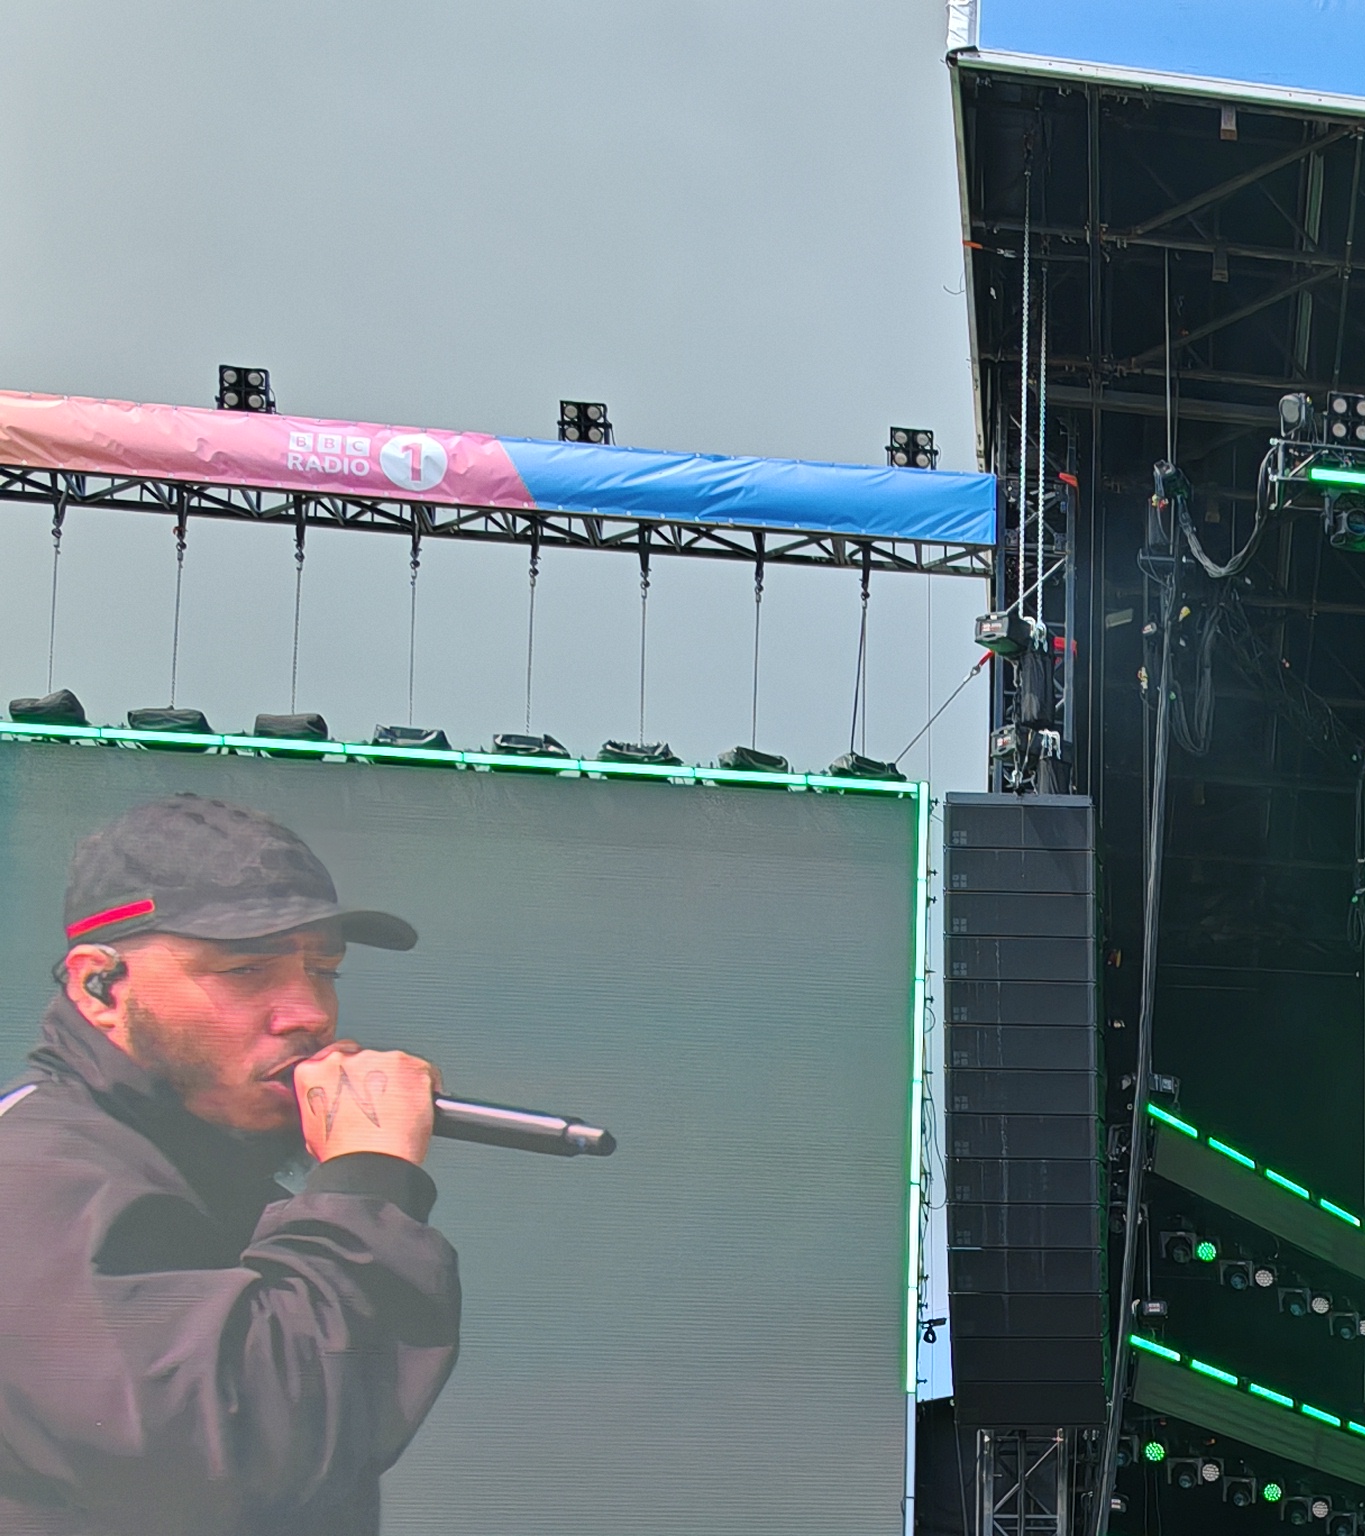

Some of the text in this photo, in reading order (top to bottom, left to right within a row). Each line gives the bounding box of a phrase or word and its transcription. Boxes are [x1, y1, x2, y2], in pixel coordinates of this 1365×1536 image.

[296, 434, 365, 453] BBC
[286, 452, 370, 477] RADIO
[401, 442, 423, 482] 1
